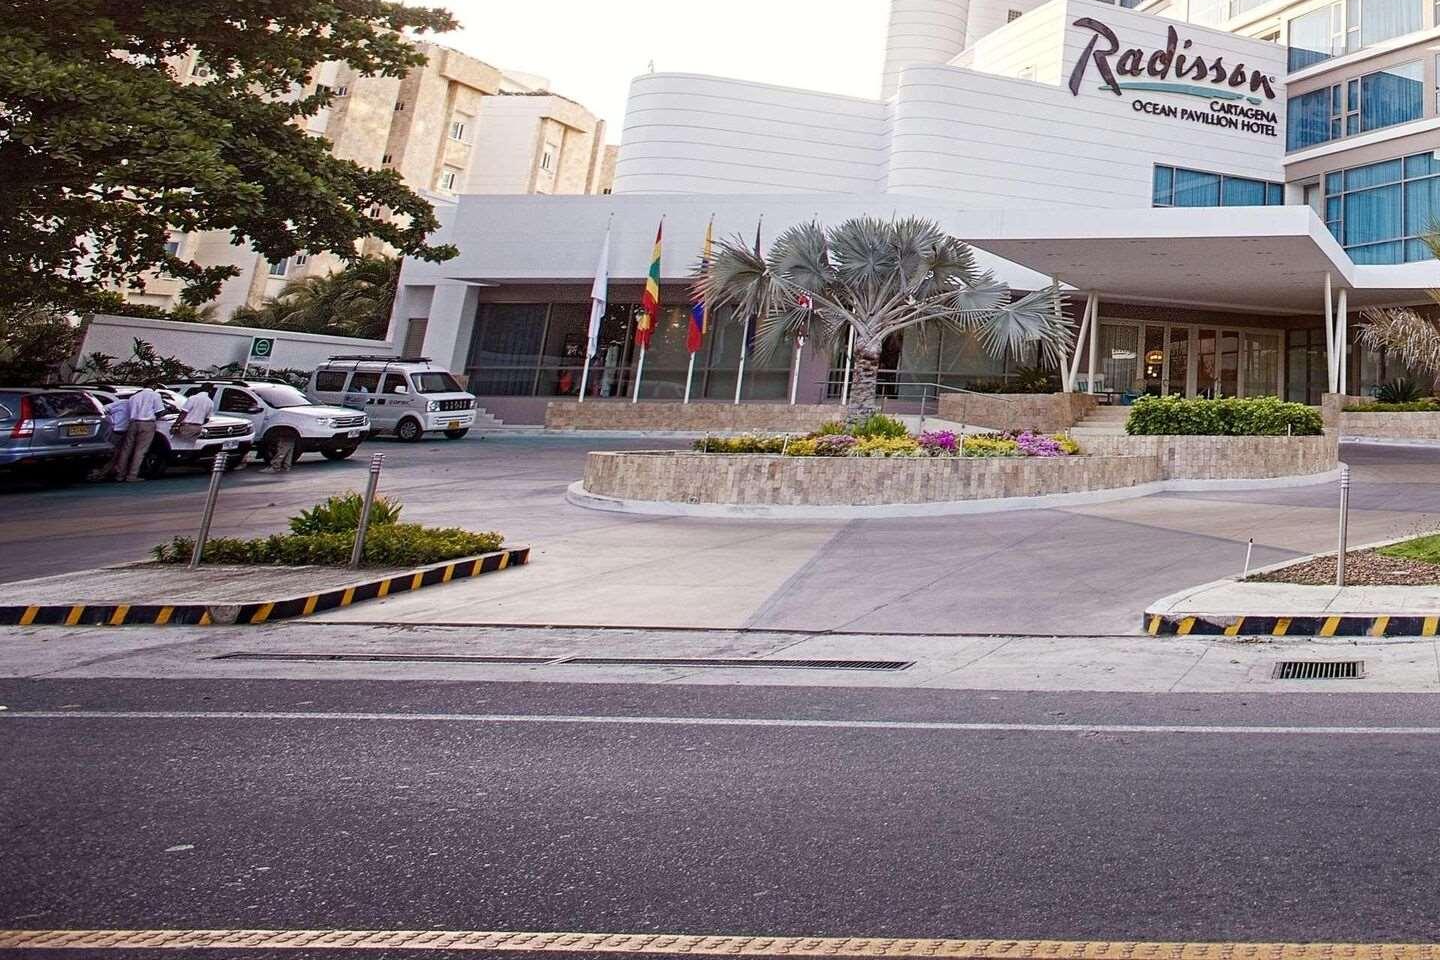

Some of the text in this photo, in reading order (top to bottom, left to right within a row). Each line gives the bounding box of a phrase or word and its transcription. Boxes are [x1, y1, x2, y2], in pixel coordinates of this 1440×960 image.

[1069, 17, 1276, 99] Radisson
[1132, 100, 1278, 137] OCEAN PAVILLION HOTEL
[1210, 101, 1278, 124] CARTAGENA
